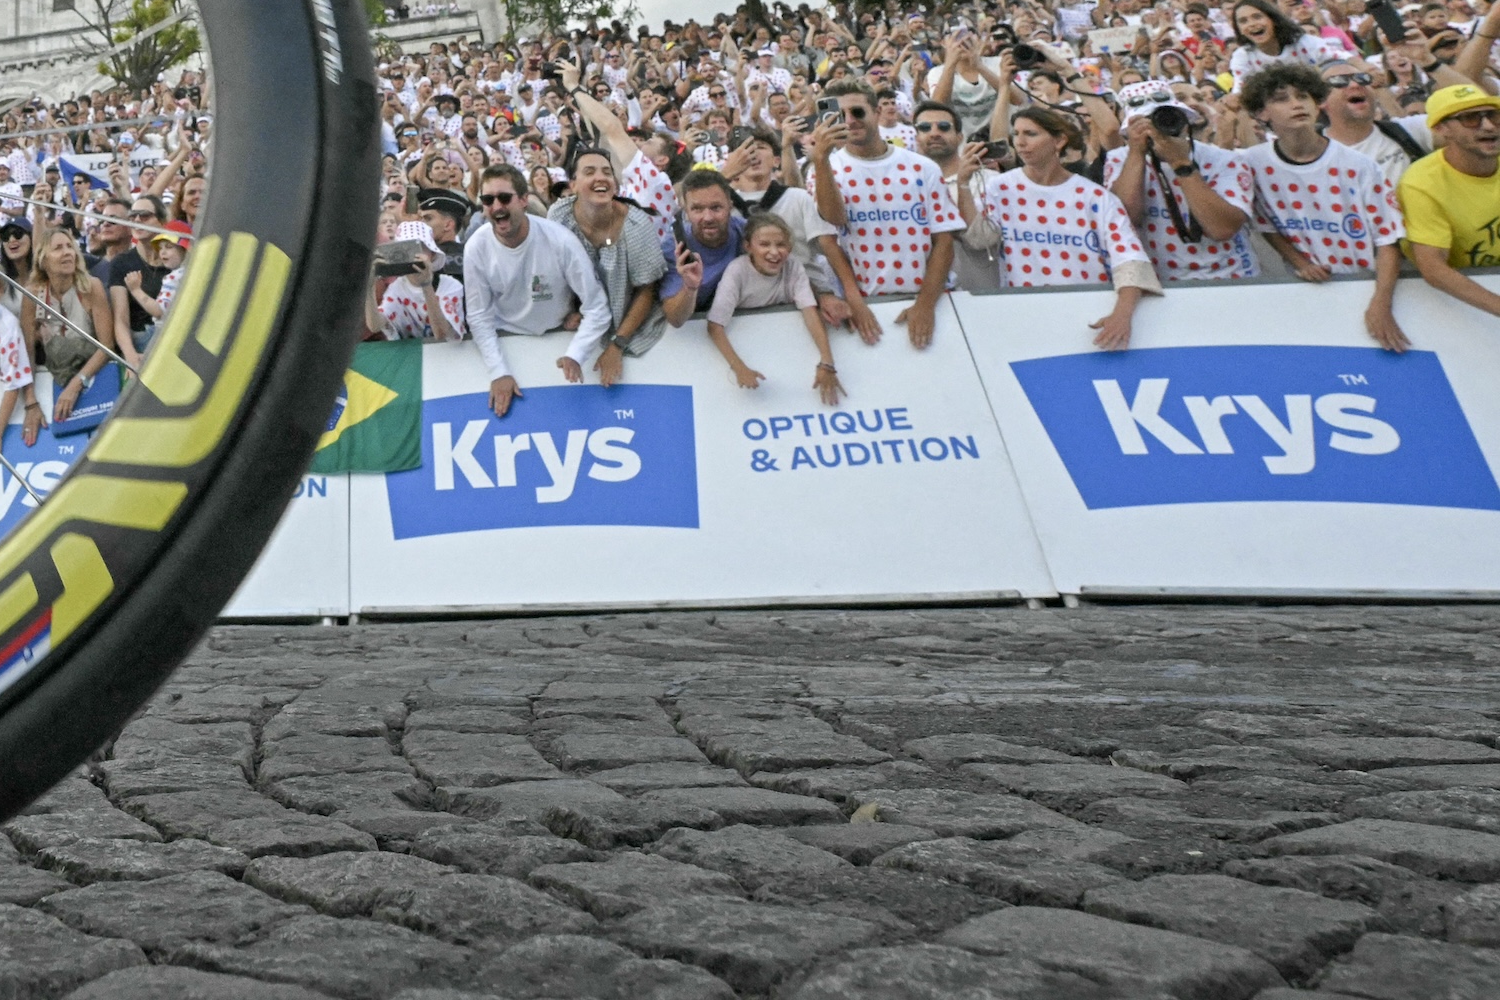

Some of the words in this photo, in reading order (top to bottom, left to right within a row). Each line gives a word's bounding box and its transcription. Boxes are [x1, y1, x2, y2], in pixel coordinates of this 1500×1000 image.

[847, 207, 910, 223] Leclerc
[742, 407, 913, 441] OPTIQUE
[1091, 377, 1401, 476] Krys
[432, 418, 642, 504] Krys
[750, 449, 781, 473] &
[791, 435, 981, 471] AUDITION
